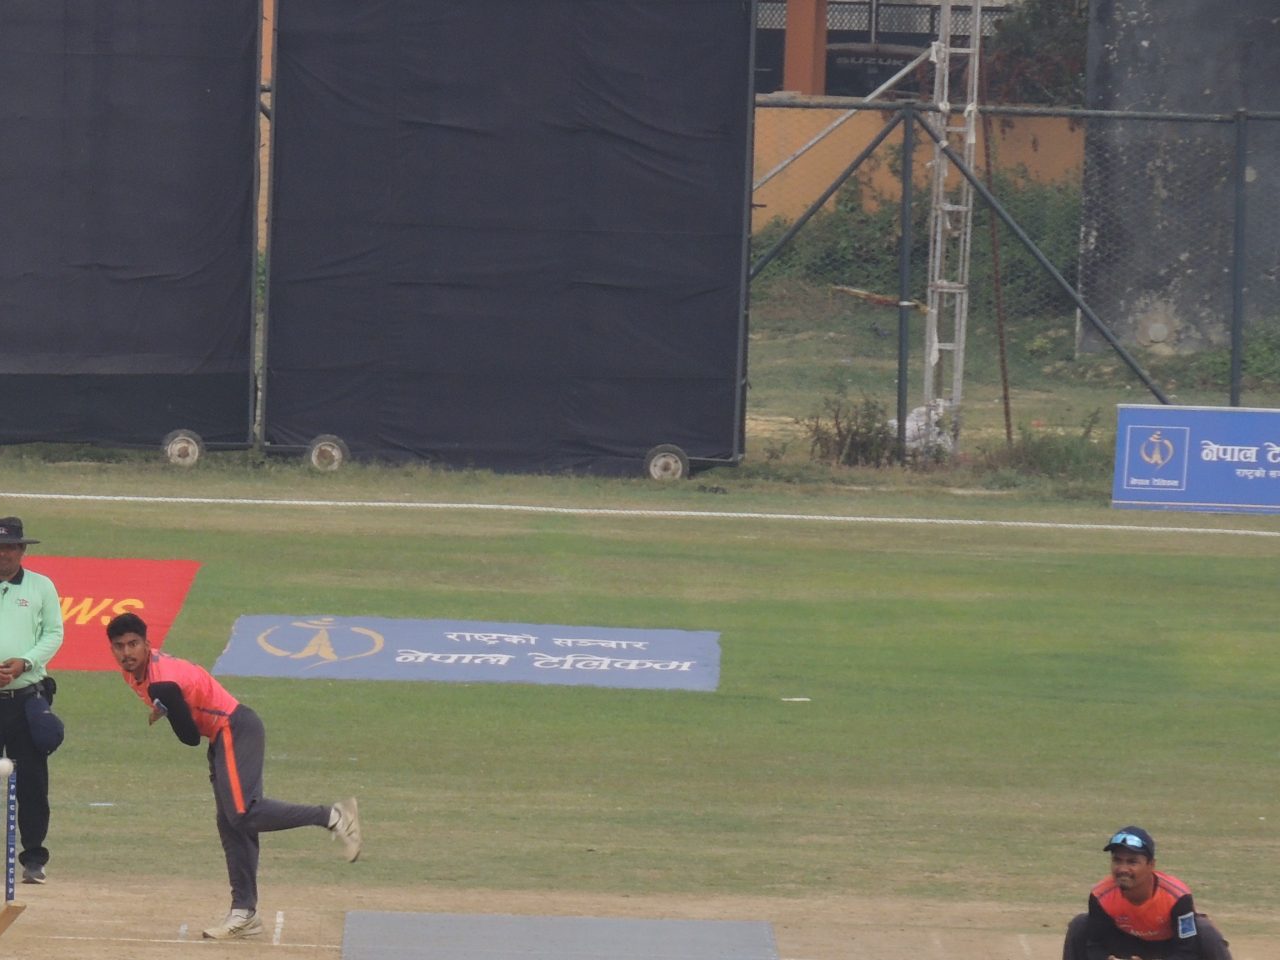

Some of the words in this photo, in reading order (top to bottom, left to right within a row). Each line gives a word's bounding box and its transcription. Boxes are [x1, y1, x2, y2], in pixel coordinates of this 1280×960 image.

[835, 56, 910, 67] SUZUK
[1201, 440, 1259, 463] नेपाल
[394, 649, 515, 666] नेपाल
[527, 652, 697, 671] टेलिकम
